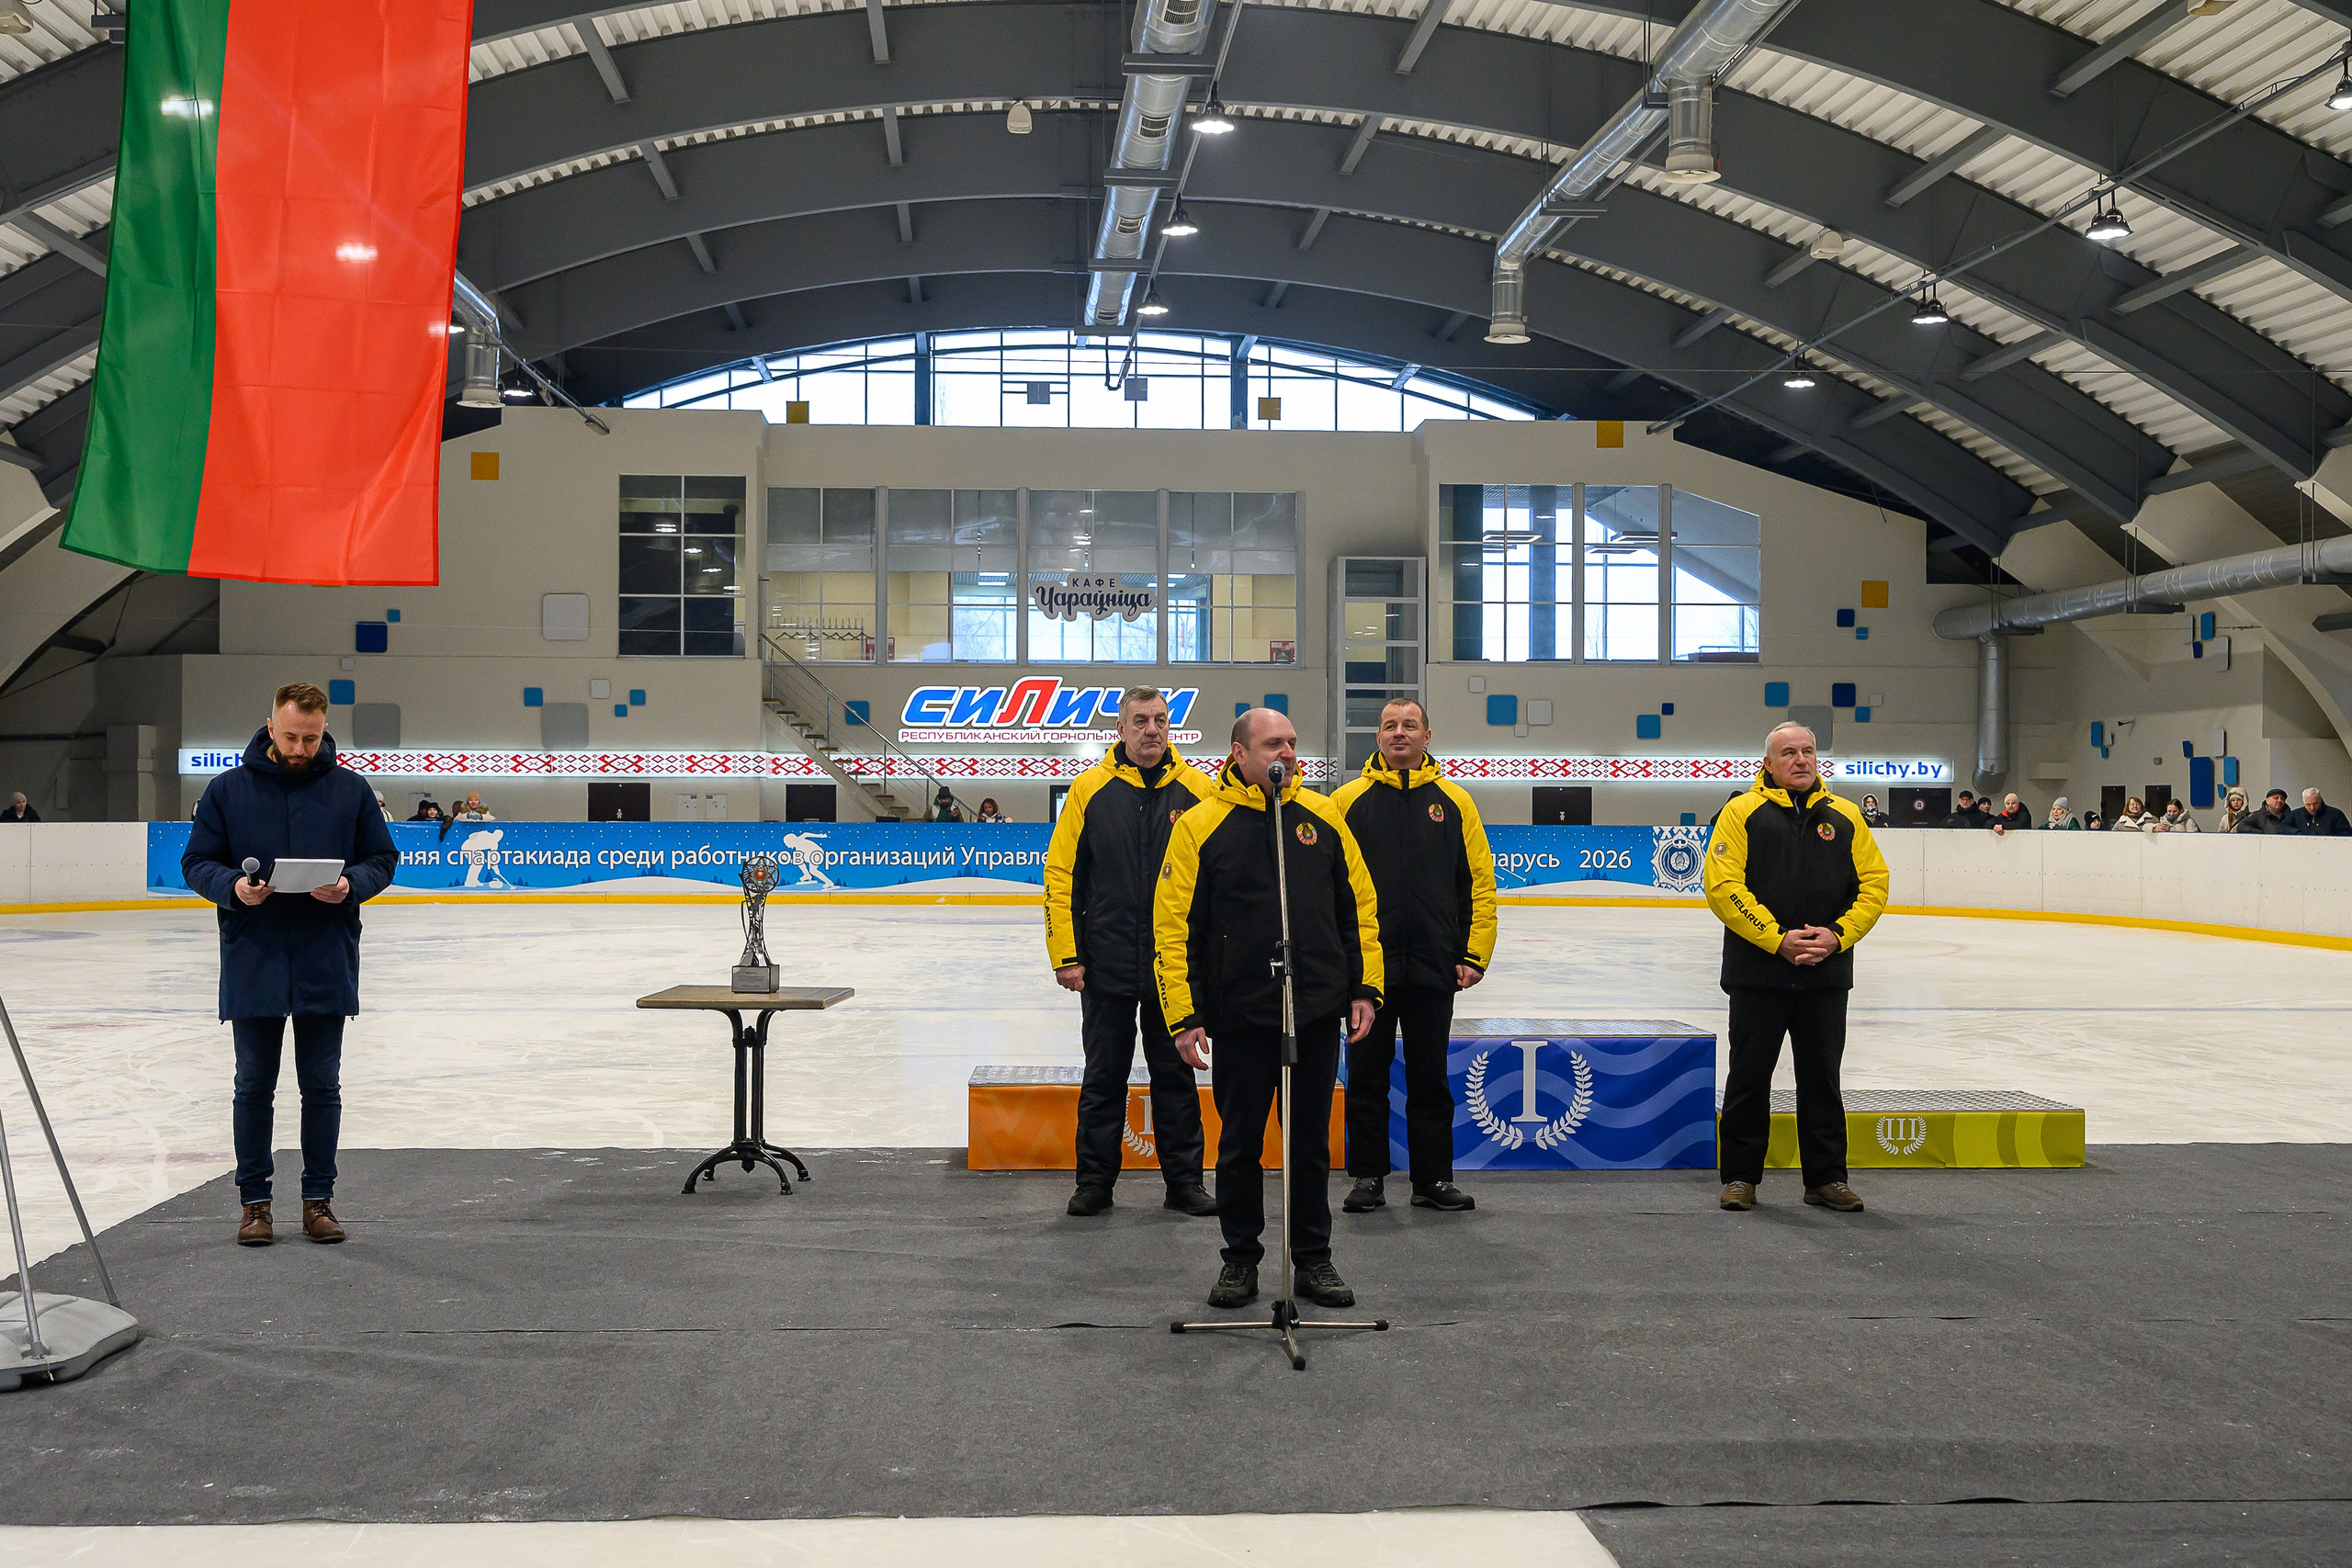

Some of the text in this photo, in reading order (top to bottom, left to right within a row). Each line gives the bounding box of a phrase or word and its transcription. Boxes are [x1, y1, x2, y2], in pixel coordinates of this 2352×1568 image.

[1072, 578, 1115, 588] КАФЕ
[1035, 585, 1152, 617] Чараўніца
[901, 730, 1040, 740] РЕСПУБЛИКАНСКИЙ
[1845, 761, 1943, 779] silichy.by
[397, 850, 440, 865] няя
[447, 850, 591, 870] спартакиада
[597, 850, 665, 870] среди
[809, 845, 956, 870] организаций
[1578, 849, 1633, 869] 2026
[1729, 893, 1767, 931] BELARUS
[1510, 1040, 1549, 1122] I
[1883, 1118, 1919, 1141] III
